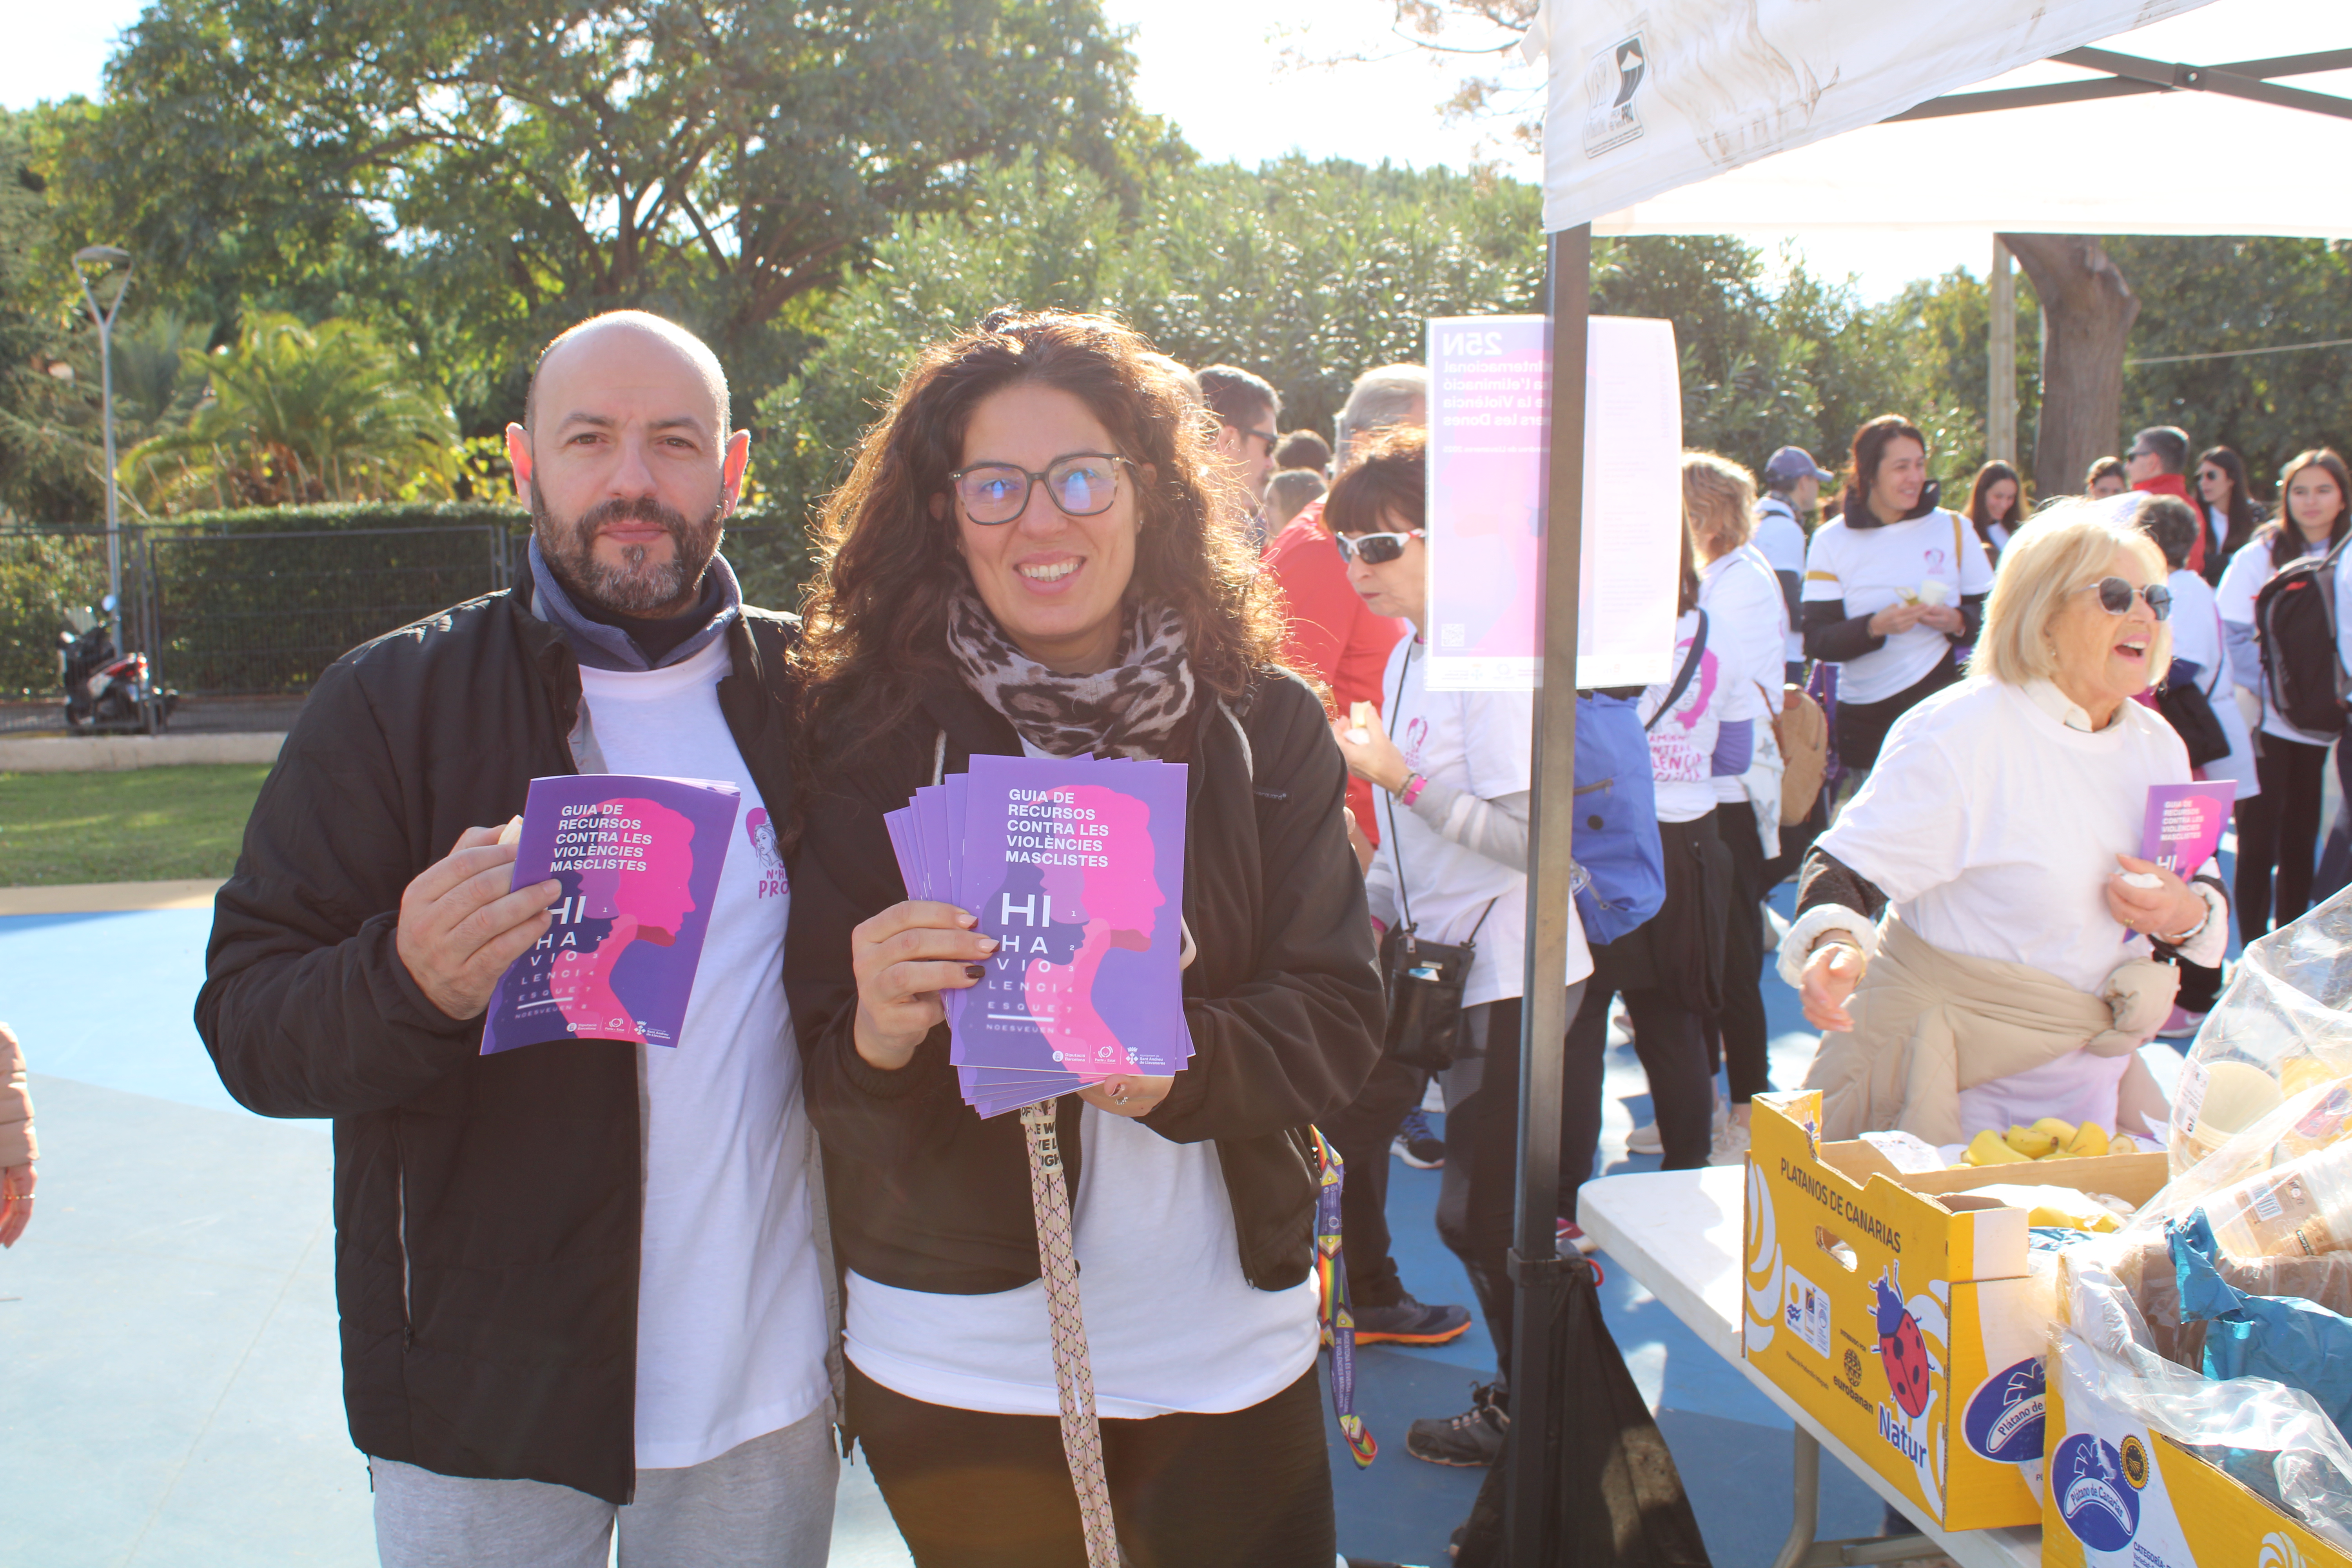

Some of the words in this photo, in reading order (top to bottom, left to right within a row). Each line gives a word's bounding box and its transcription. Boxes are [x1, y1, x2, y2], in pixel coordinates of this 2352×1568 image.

[1009, 789, 1049, 802] GUIA
[1053, 791, 1074, 804] DE
[561, 804, 598, 817] GUIA
[602, 804, 624, 815] DE
[1008, 804, 1096, 820] RECURSOS
[558, 818, 641, 831] RECURSOS
[1007, 819, 1075, 835] CONTRA
[1080, 824, 1109, 837] LES
[555, 832, 618, 844] CONTRA
[623, 832, 652, 845] LES
[1006, 835, 1103, 851] VIOLÈNCIES
[554, 843, 644, 858] VIOLÈNCIES
[1005, 850, 1108, 867] MASCLISTES
[550, 859, 647, 872] MASCLISTES
[759, 880, 789, 899] PRO
[1001, 893, 1051, 927] HI
[1002, 935, 1048, 954] HA
[1781, 1157, 1828, 1205] PLATANOS
[1830, 1190, 1843, 1216] DE
[1846, 1201, 1901, 1254] CANARIAS
[1833, 1375, 1874, 1414] eurobanan
[1997, 1408, 2030, 1436] Plátano
[2032, 1401, 2043, 1412] de
[1879, 1405, 1927, 1468] Natur
[2070, 1487, 2090, 1506] Plátano
[2091, 1483, 2098, 1496] de
[2099, 1486, 2123, 1517] Canarias
